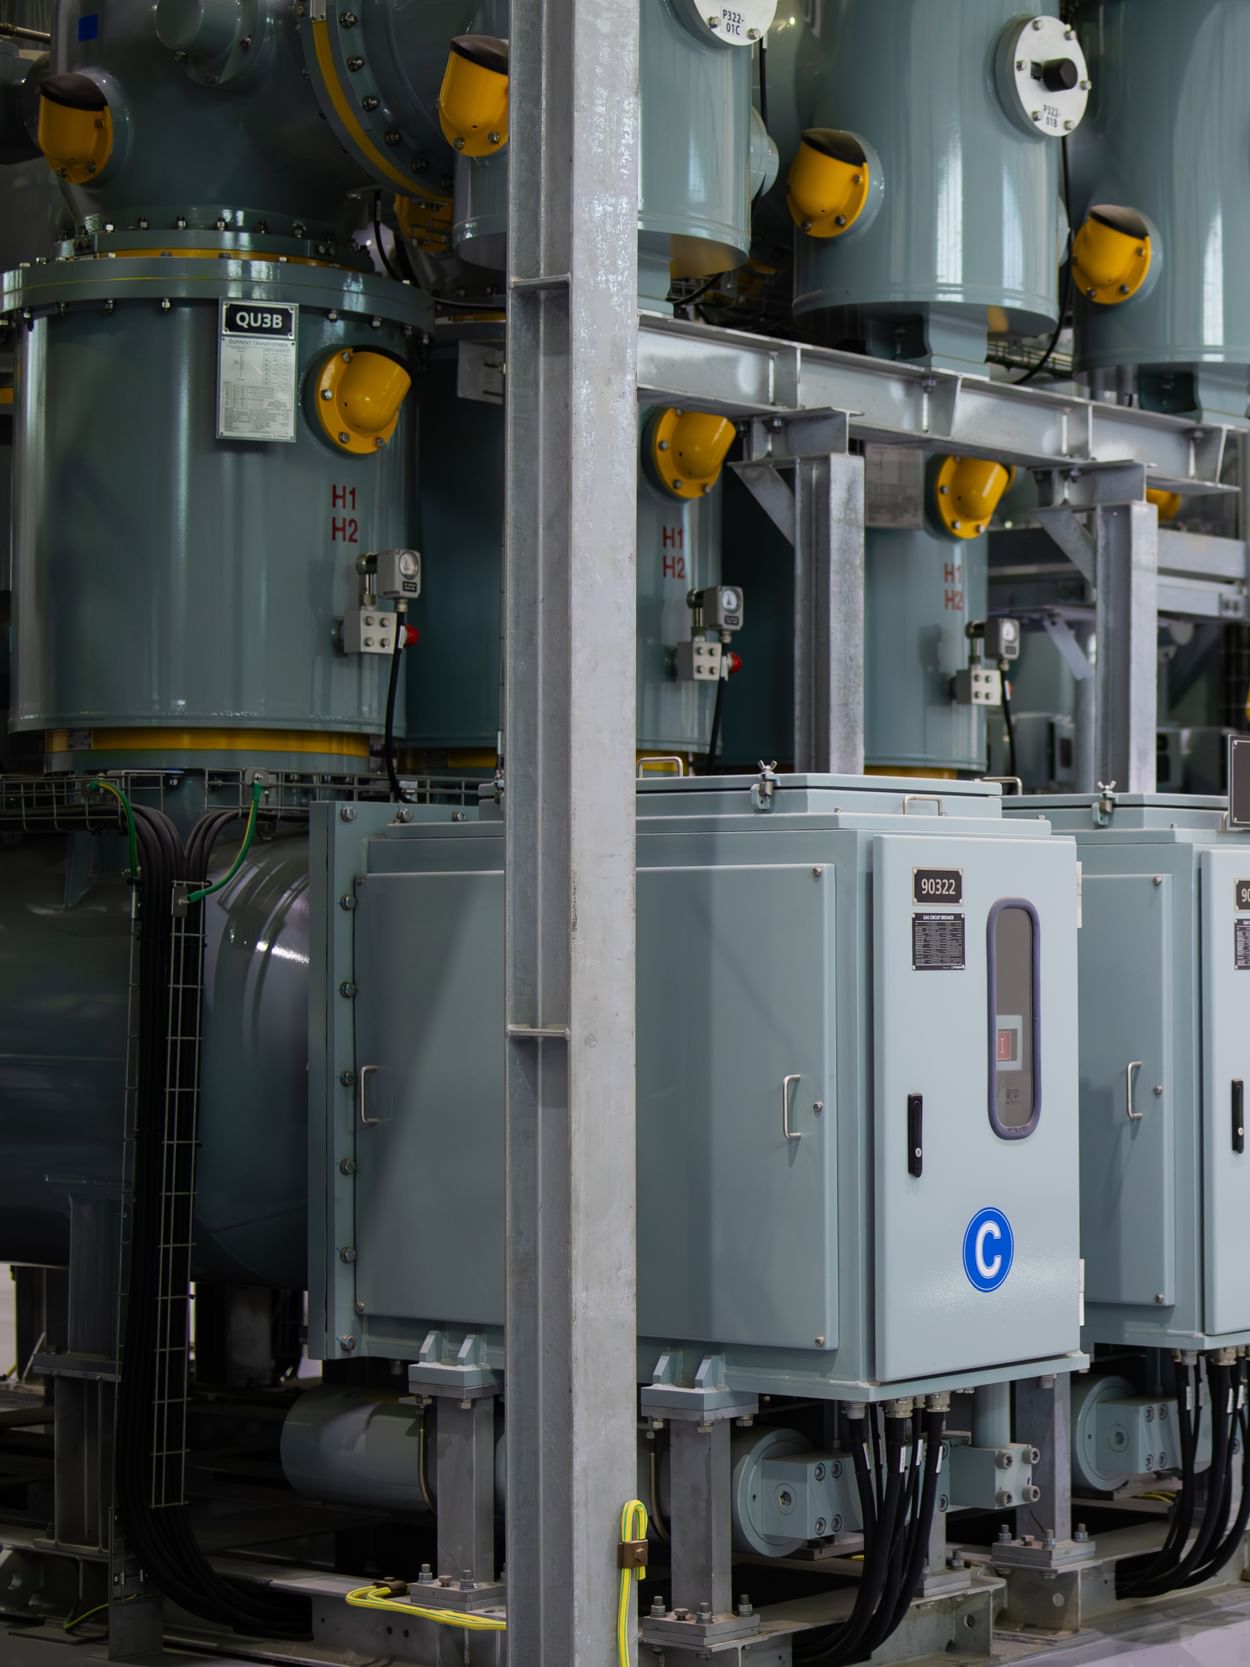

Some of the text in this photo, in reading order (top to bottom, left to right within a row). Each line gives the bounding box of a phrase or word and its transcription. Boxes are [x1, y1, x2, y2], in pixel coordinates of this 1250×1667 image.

[723, 9, 744, 24] P322-
[726, 23, 740, 36] 01C
[235, 311, 283, 329] QU3B
[332, 484, 356, 511] H1
[332, 516, 358, 543] H2
[662, 526, 684, 549] H1
[663, 555, 685, 580] H2
[944, 562, 961, 584] H1
[944, 589, 964, 611] H2
[921, 878, 956, 895] 90322
[975, 1220, 1002, 1279] C
